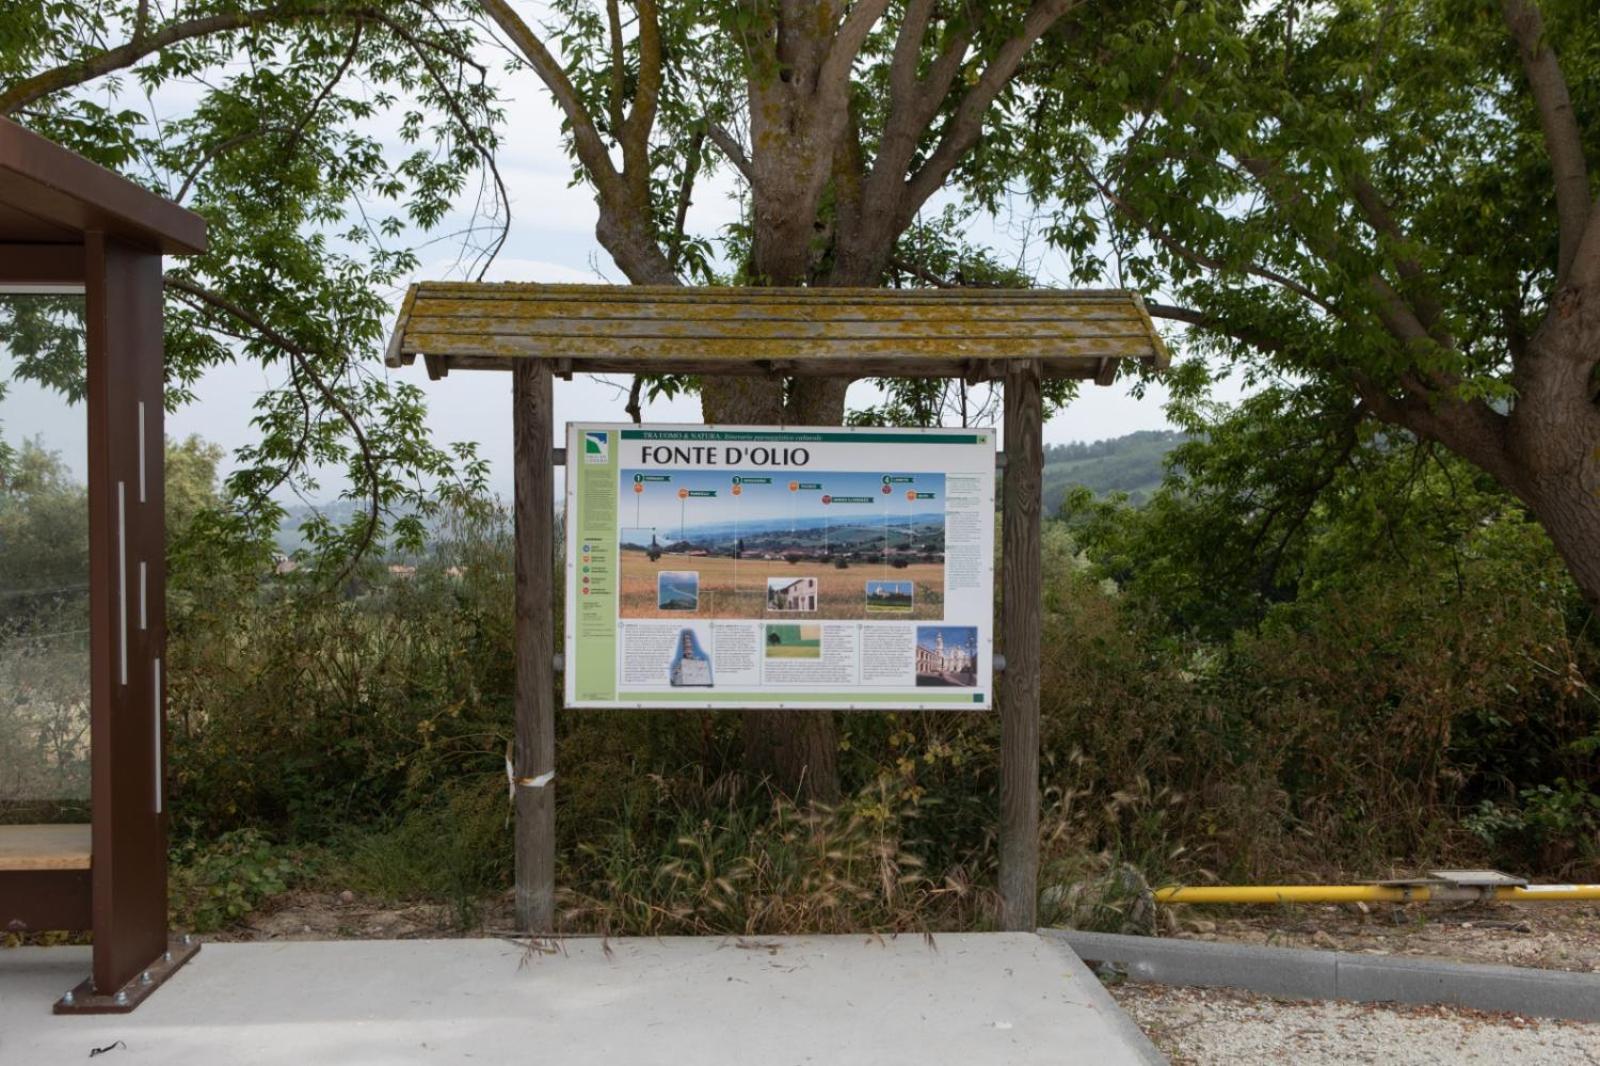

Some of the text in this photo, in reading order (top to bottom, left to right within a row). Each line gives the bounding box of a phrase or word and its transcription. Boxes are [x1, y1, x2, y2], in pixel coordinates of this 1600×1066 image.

[643, 431, 658, 440] TRA
[641, 446, 810, 466] FONTE D'OLIO
